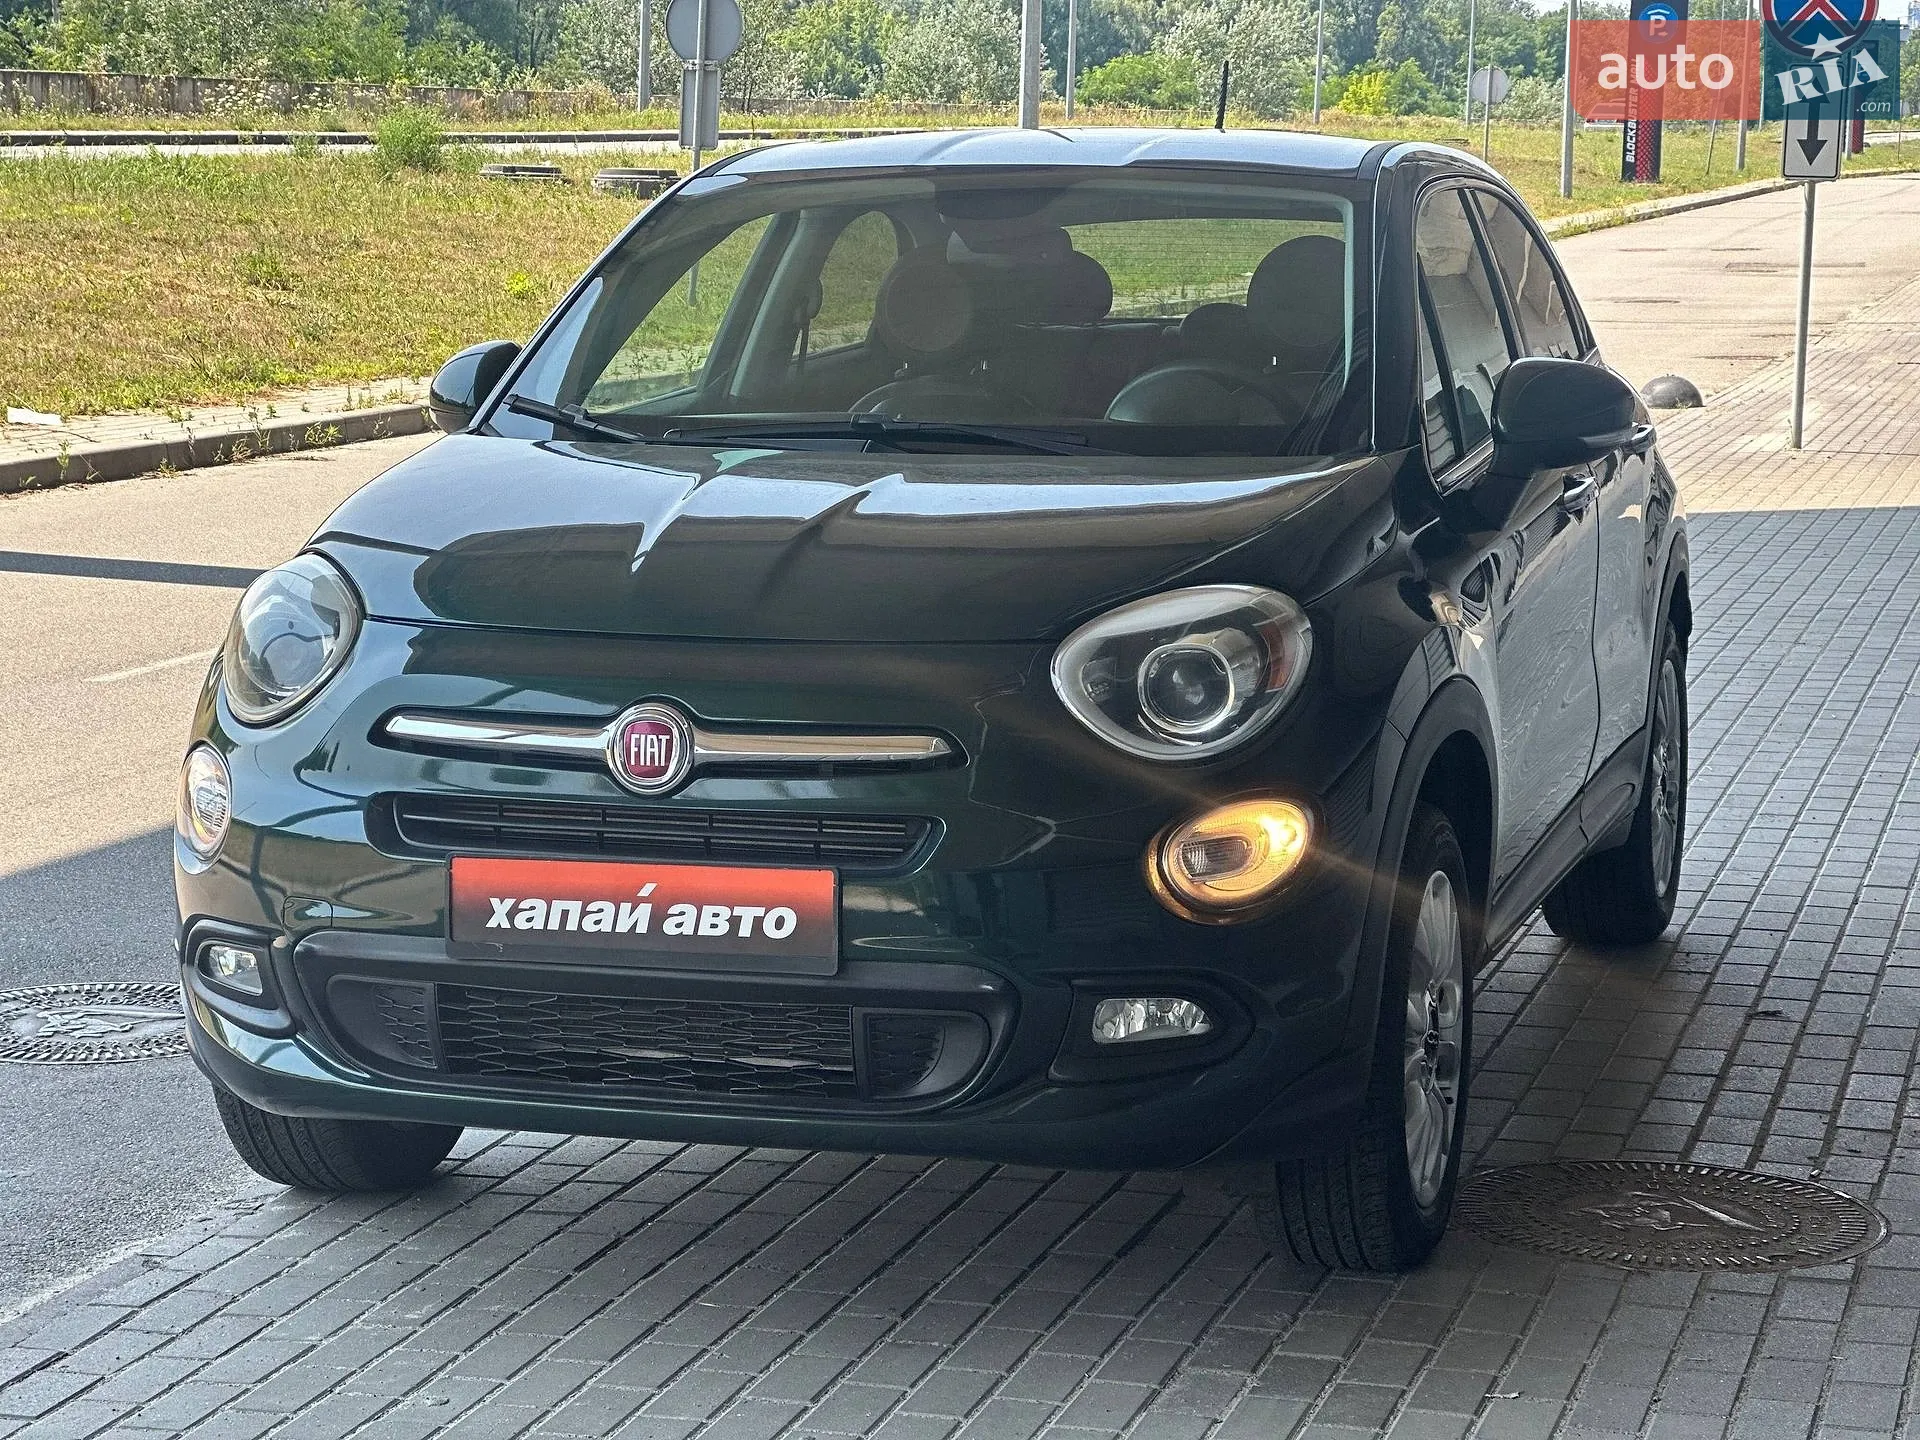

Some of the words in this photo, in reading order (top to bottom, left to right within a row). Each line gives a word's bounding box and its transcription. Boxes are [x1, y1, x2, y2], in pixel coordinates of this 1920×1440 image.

[1625, 88, 1638, 163] BLOCKBUSTER
[630, 733, 670, 767] FIAT
[662, 901, 798, 940] авто
